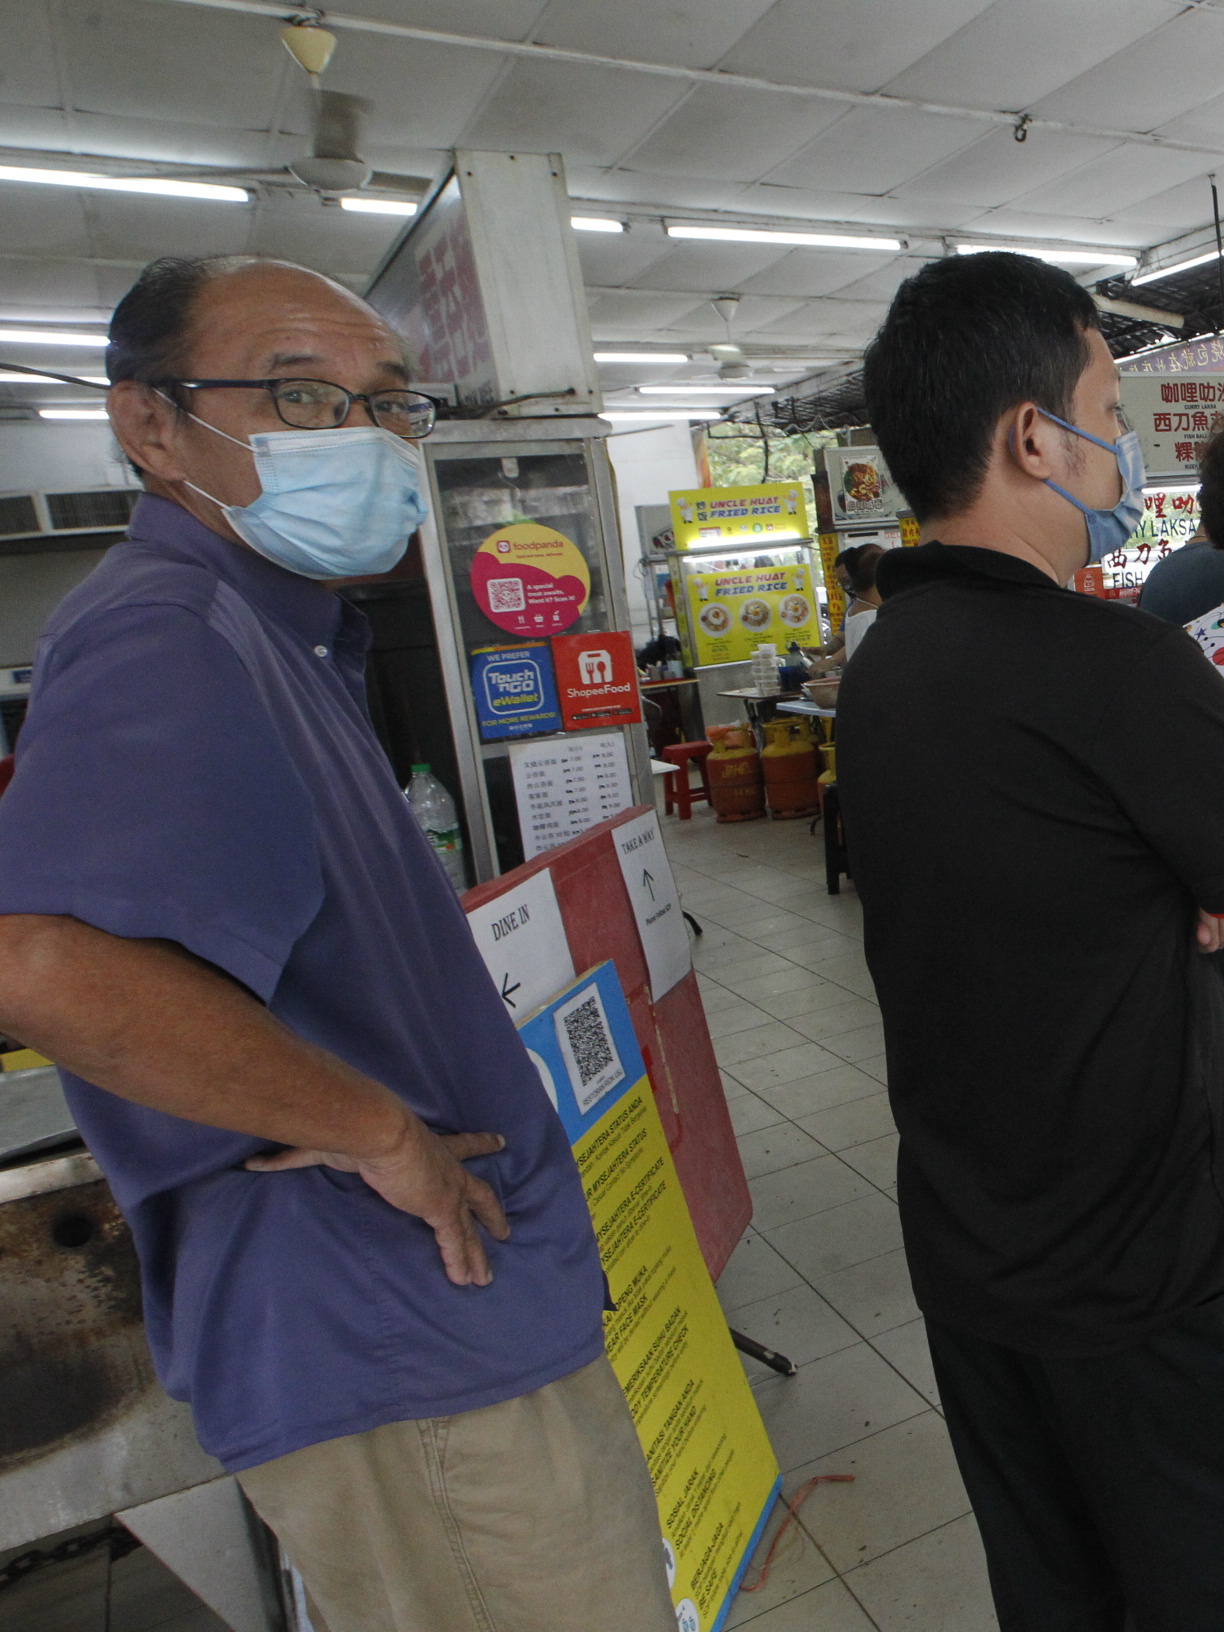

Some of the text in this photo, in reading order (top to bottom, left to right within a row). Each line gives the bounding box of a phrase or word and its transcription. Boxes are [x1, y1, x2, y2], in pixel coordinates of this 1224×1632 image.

[710, 497, 779, 509] UNCLE HUAT
[710, 505, 781, 518] FRIED RICE
[1151, 518, 1197, 537] LAKSA
[513, 540, 564, 551] foodpanda
[715, 572, 786, 586] UNCLE HUAT
[1112, 571, 1143, 589] FISH
[715, 582, 788, 596] FRIED RICE
[486, 651, 530, 662] WE PREFER
[488, 669, 534, 684] Touch
[567, 683, 631, 699] ShopeeFood
[493, 693, 539, 707] eWallet
[497, 717, 519, 726] MORE
[621, 838, 638, 855] TAKE
[491, 904, 530, 941] DINE IN
[608, 1109, 629, 1133] STATUS
[627, 1095, 642, 1114] ANDA
[591, 1147, 630, 1192] MYSEJAHTERA
[627, 1127, 648, 1152] STATUS
[631, 1264, 647, 1287] MUKA
[618, 1312, 633, 1335] FACE
[631, 1292, 648, 1316] MASK
